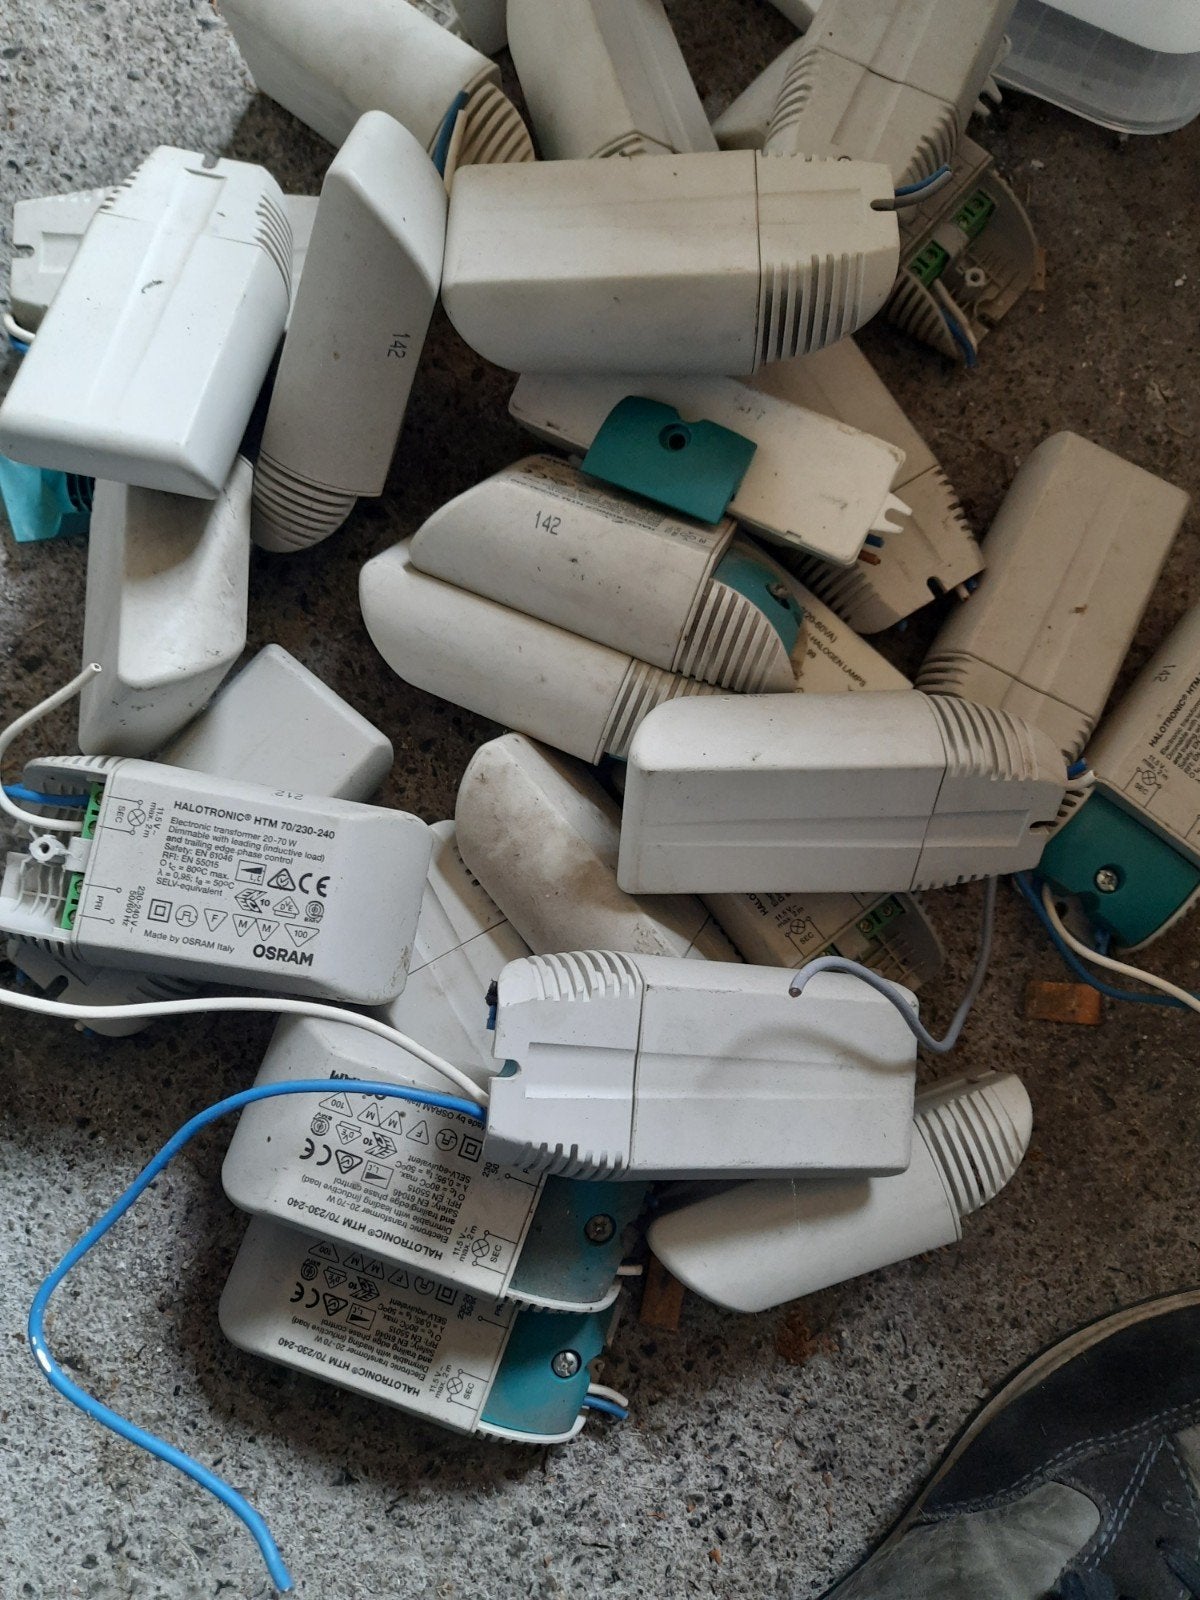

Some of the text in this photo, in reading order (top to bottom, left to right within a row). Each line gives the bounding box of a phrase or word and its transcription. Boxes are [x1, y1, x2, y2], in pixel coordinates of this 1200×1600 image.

[391, 333, 411, 359] 142
[535, 510, 561, 536] 142
[810, 636, 843, 667] HALOGEN
[114, 805, 125, 823] SEC
[173, 799, 335, 839] HALOTRONIC® HTM 70/230-240
[169, 816, 297, 847] Electronic transformer 20-70 W
[163, 842, 233, 862] Safety: EN 61046
[165, 833, 293, 864] and trailing edge phase control
[167, 824, 325, 863] Dimmable with leading (inductive load)
[161, 851, 219, 868] RFI: EN 55015
[209, 870, 229, 879] max.
[155, 876, 223, 898] SELV-equivalent
[94, 895, 104, 910] PRI
[121, 889, 136, 926] 50/60 Hz
[131, 885, 145, 919] 230-240
[259, 898, 270, 906] 10
[238, 919, 248, 928] M
[261, 923, 271, 932] M
[293, 929, 308, 938] 100
[800, 931, 815, 945] SEC
[143, 929, 234, 954] Made by OSRAM Italy
[251, 942, 314, 968] OSRAM
[330, 1098, 345, 1109] 100
[422, 1102, 467, 1123] by OSRAM
[365, 1110, 375, 1120] M
[387, 1118, 397, 1128] M
[361, 1136, 373, 1146] 10
[397, 1170, 418, 1182] max.
[405, 1153, 472, 1188] SELV-equivalent
[300, 1173, 452, 1234] Dimmable with leading (inductive load)
[362, 1186, 388, 1201] phase
[388, 1195, 410, 1209] edge
[392, 1188, 459, 1218] Safety: EN 61046
[406, 1183, 462, 1209] RFI: EN 55015
[325, 1194, 448, 1243] Electronic transformer 20-70 W
[409, 1203, 438, 1219] trailing
[439, 1214, 455, 1225] and
[286, 1196, 443, 1260] HALOTRONIC® HTM 70/230-240
[452, 1239, 463, 1256] 11.5
[458, 1241, 470, 1262] max.
[469, 1224, 477, 1234] m
[489, 1243, 502, 1263] SEC
[347, 1280, 358, 1290] 10
[388, 1297, 448, 1325] SELV-equivalent
[320, 1318, 432, 1365] and trailing edge phase control
[387, 1325, 410, 1338] 55015
[396, 1337, 409, 1347] EN
[410, 1333, 422, 1343] EN
[290, 1315, 429, 1373] Dimmable with leading (inductive load)
[276, 1336, 420, 1397] HALOTRONIC® HTM 70/230-240
[314, 1334, 425, 1381] Electronic transformer 20-70 W
[462, 1381, 474, 1400] SEC
